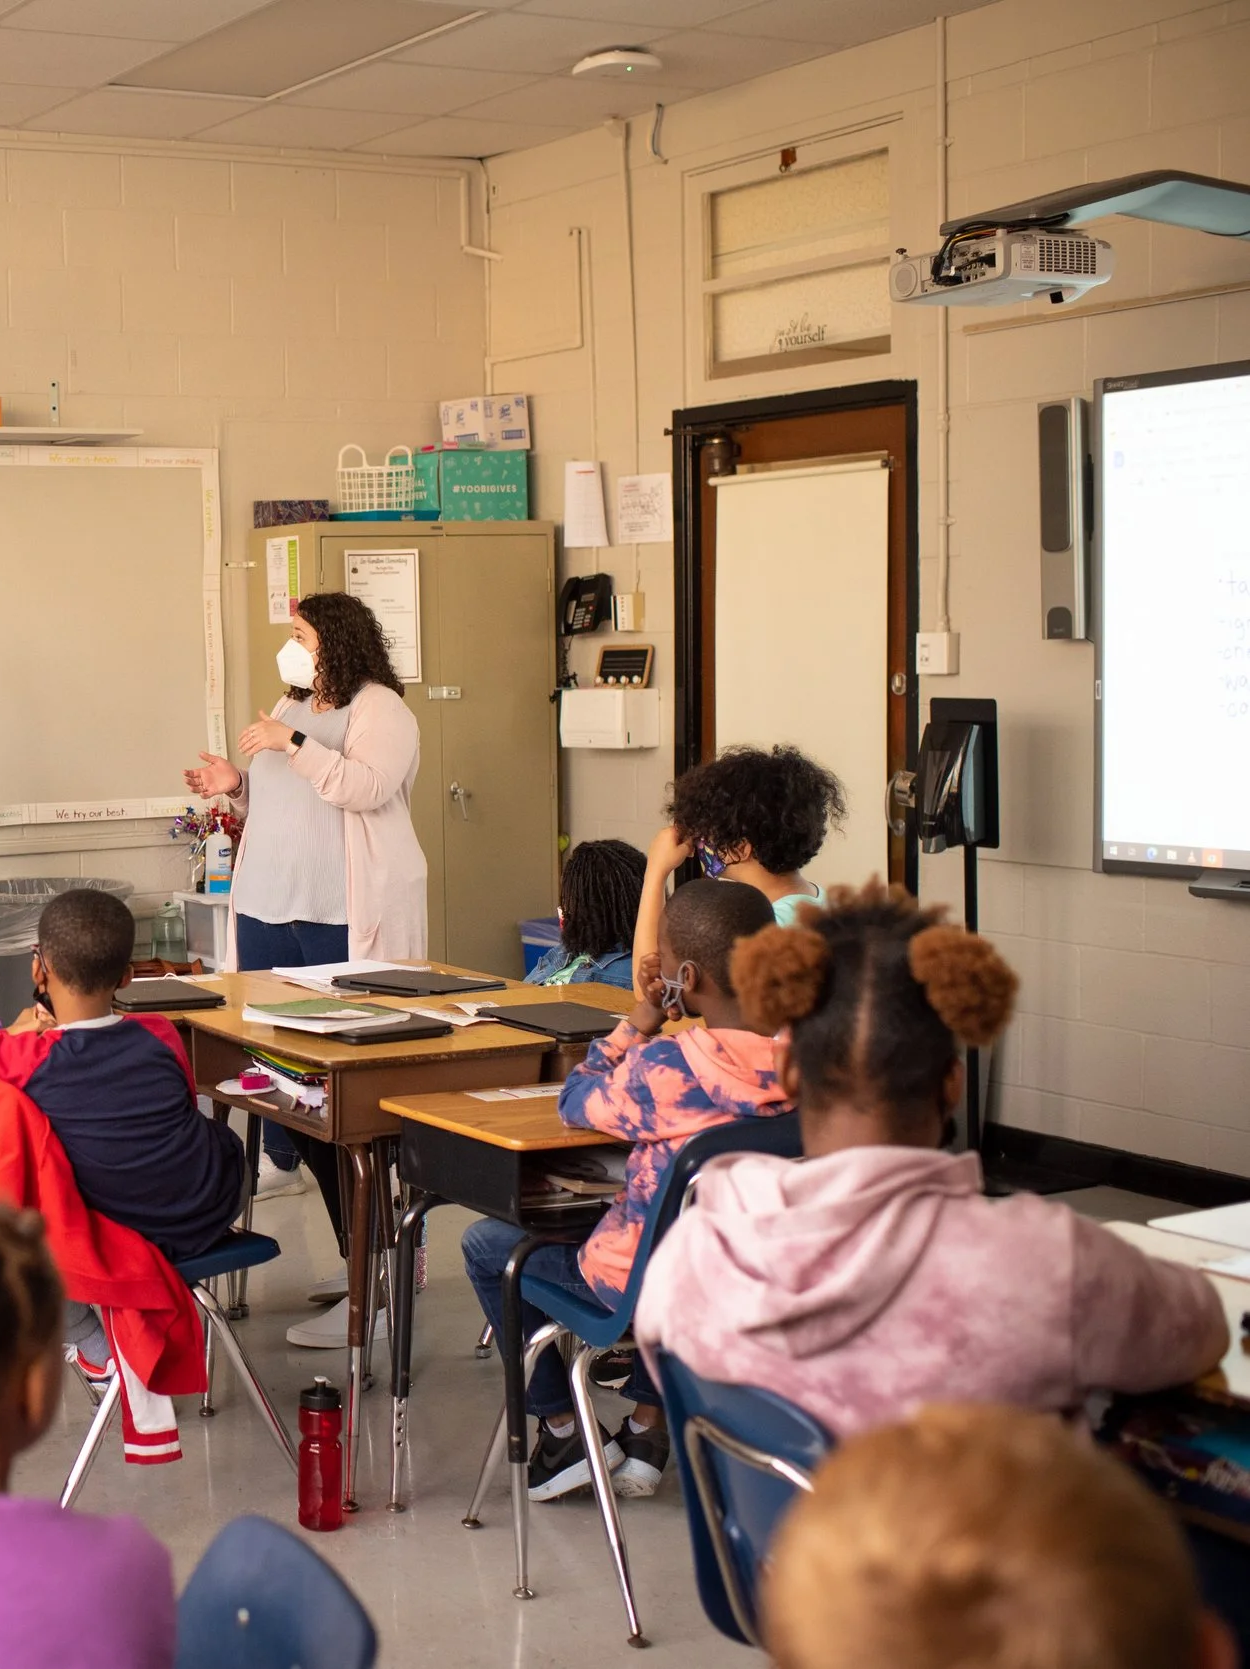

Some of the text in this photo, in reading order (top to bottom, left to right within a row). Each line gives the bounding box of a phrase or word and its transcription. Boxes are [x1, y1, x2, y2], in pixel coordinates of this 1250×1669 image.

[784, 323, 828, 350] yourself
[452, 484, 518, 493] #YOOBIGIVES
[55, 809, 70, 820] We
[73, 809, 86, 821] try
